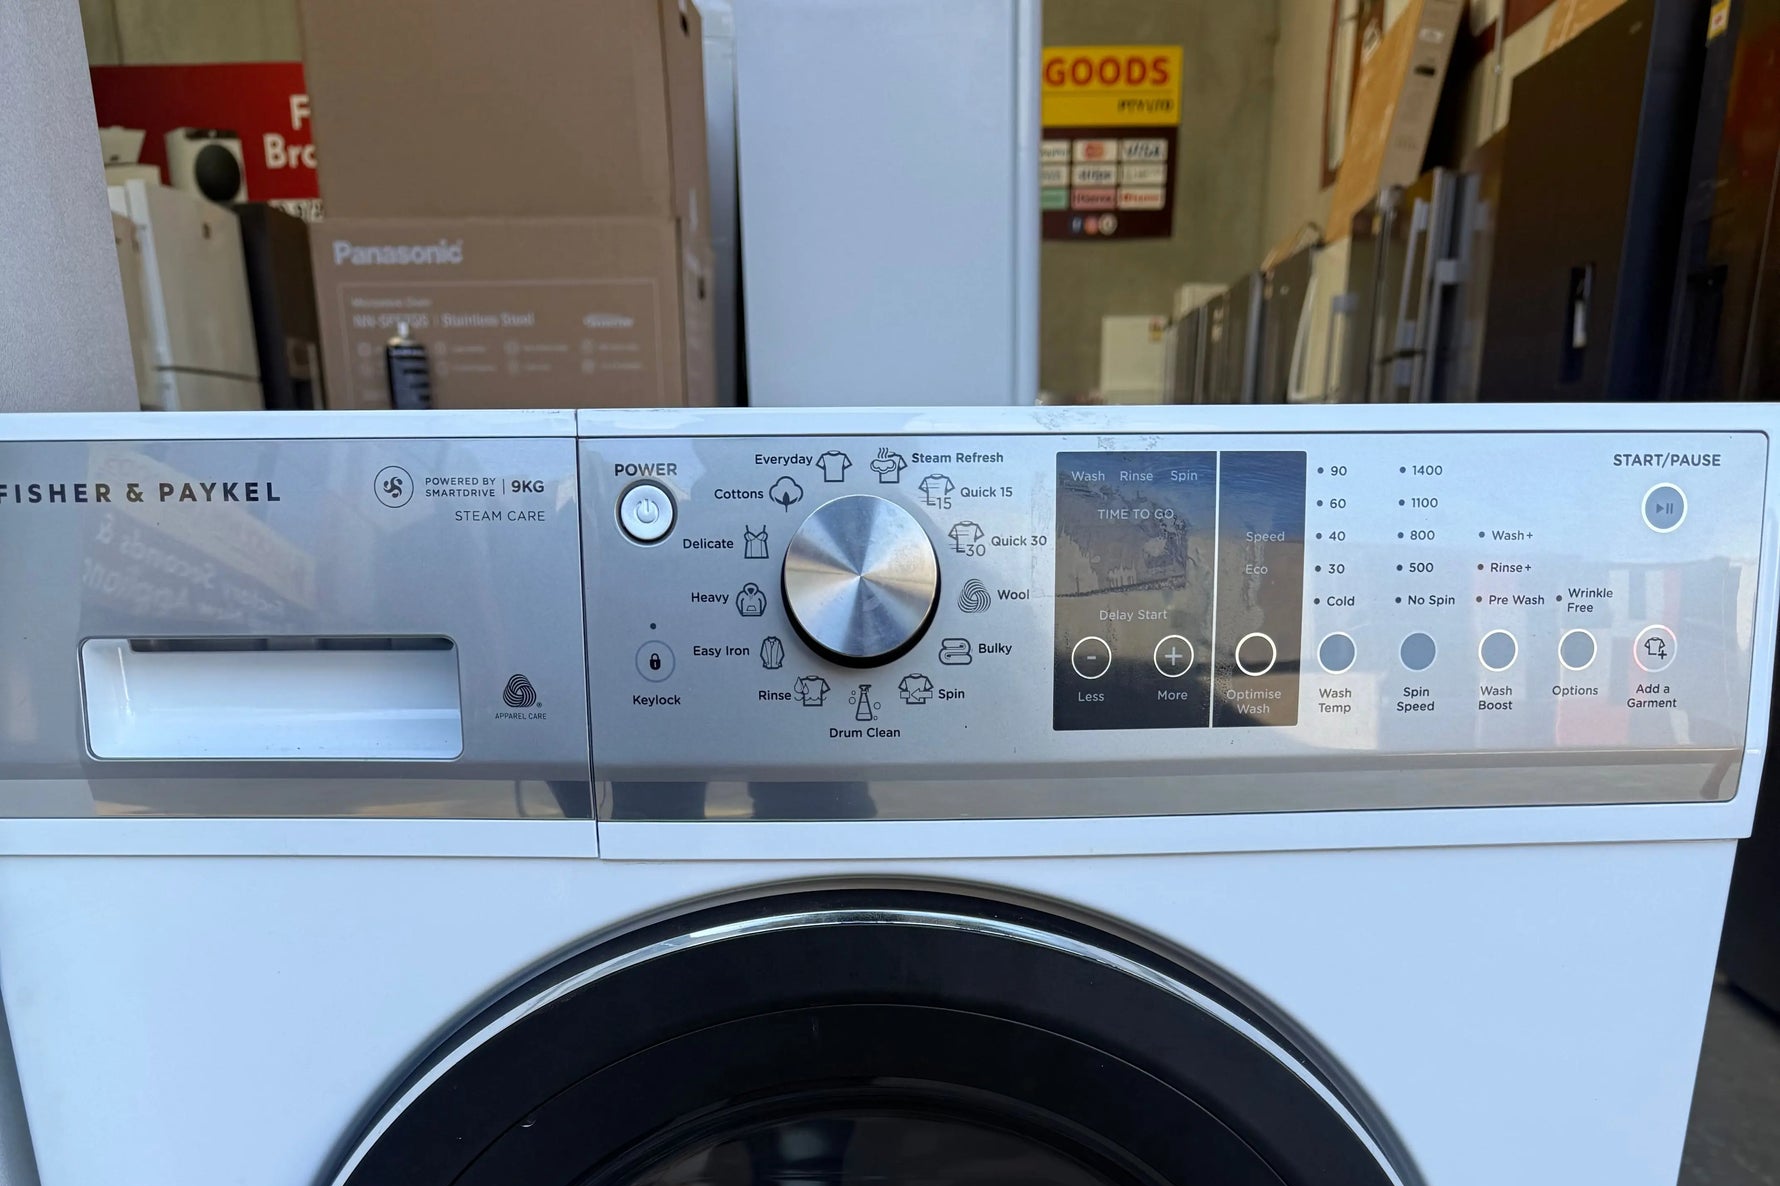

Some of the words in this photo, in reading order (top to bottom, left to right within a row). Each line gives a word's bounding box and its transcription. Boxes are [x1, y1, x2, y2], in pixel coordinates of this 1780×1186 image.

[1045, 57, 1169, 86] GOODS
[333, 239, 463, 265] Panasonic
[755, 454, 813, 467] Everyday
[912, 452, 951, 463] Steam
[955, 452, 1004, 463] Refresh
[1613, 452, 1721, 468] START/PAUSE
[614, 463, 678, 476] POWER
[1330, 465, 1347, 476] 90
[1412, 465, 1443, 476] 1400
[1071, 471, 1105, 481] Wash
[1120, 471, 1153, 481] Rinse
[1171, 470, 1197, 483] Spin
[0, 484, 111, 503] FISHER
[126, 483, 144, 502] &
[159, 482, 280, 502] PAYKEL
[511, 480, 544, 493] 9KG
[960, 486, 997, 499] Quick
[1001, 487, 1013, 498] 15
[426, 489, 495, 497] SMARTDRIVE
[714, 488, 764, 500] Cottons
[1329, 498, 1346, 509] 60
[1411, 497, 1438, 508] 1100
[455, 511, 502, 521] STEAM
[508, 511, 545, 521] CARE
[1098, 509, 1130, 520] TIME
[1133, 509, 1150, 520] TO
[1154, 509, 1174, 520] GO
[991, 535, 1028, 547] Quick
[1031, 535, 1047, 546] 30
[1246, 531, 1284, 544] Speed
[1328, 531, 1346, 542] 40
[1410, 530, 1435, 541] 800
[1492, 530, 1533, 541] Wash+
[683, 538, 734, 549] Delicate
[1246, 565, 1268, 575] Eco
[1328, 563, 1345, 575] 30
[1409, 562, 1434, 573] 500
[1490, 562, 1531, 573] Rinse+
[691, 592, 729, 605] Heavy
[997, 589, 1030, 600] Wool
[1568, 587, 1613, 599] Wrinkle
[1327, 595, 1355, 607] Cold
[1408, 595, 1426, 605] No
[1429, 594, 1455, 608] Spin
[1489, 595, 1507, 605] Pre
[1511, 594, 1545, 605] Wash
[1567, 602, 1593, 613] Free
[1100, 610, 1133, 623] Delay
[1137, 609, 1168, 620] Start
[693, 645, 720, 659] Easy
[724, 645, 749, 656] Iron
[978, 642, 1012, 656] Bulky
[758, 689, 792, 701] Rinse
[938, 688, 965, 702] Spin
[1319, 687, 1352, 699] Wash
[1403, 686, 1430, 701] Spin
[1480, 685, 1513, 697] Wash
[1552, 685, 1598, 698] Options
[1636, 683, 1660, 695] Add
[1663, 686, 1670, 695] a
[633, 694, 681, 707] Keylock
[1078, 692, 1104, 702] Less
[1158, 690, 1187, 701] More
[1227, 689, 1281, 702] Optimise
[1237, 703, 1270, 714] Wash
[1319, 702, 1351, 716] Temp
[1397, 700, 1435, 714] Speed
[1478, 700, 1513, 711] Boost
[1627, 697, 1677, 709] Garment
[829, 727, 864, 738] Drum
[868, 727, 900, 738] Clean
